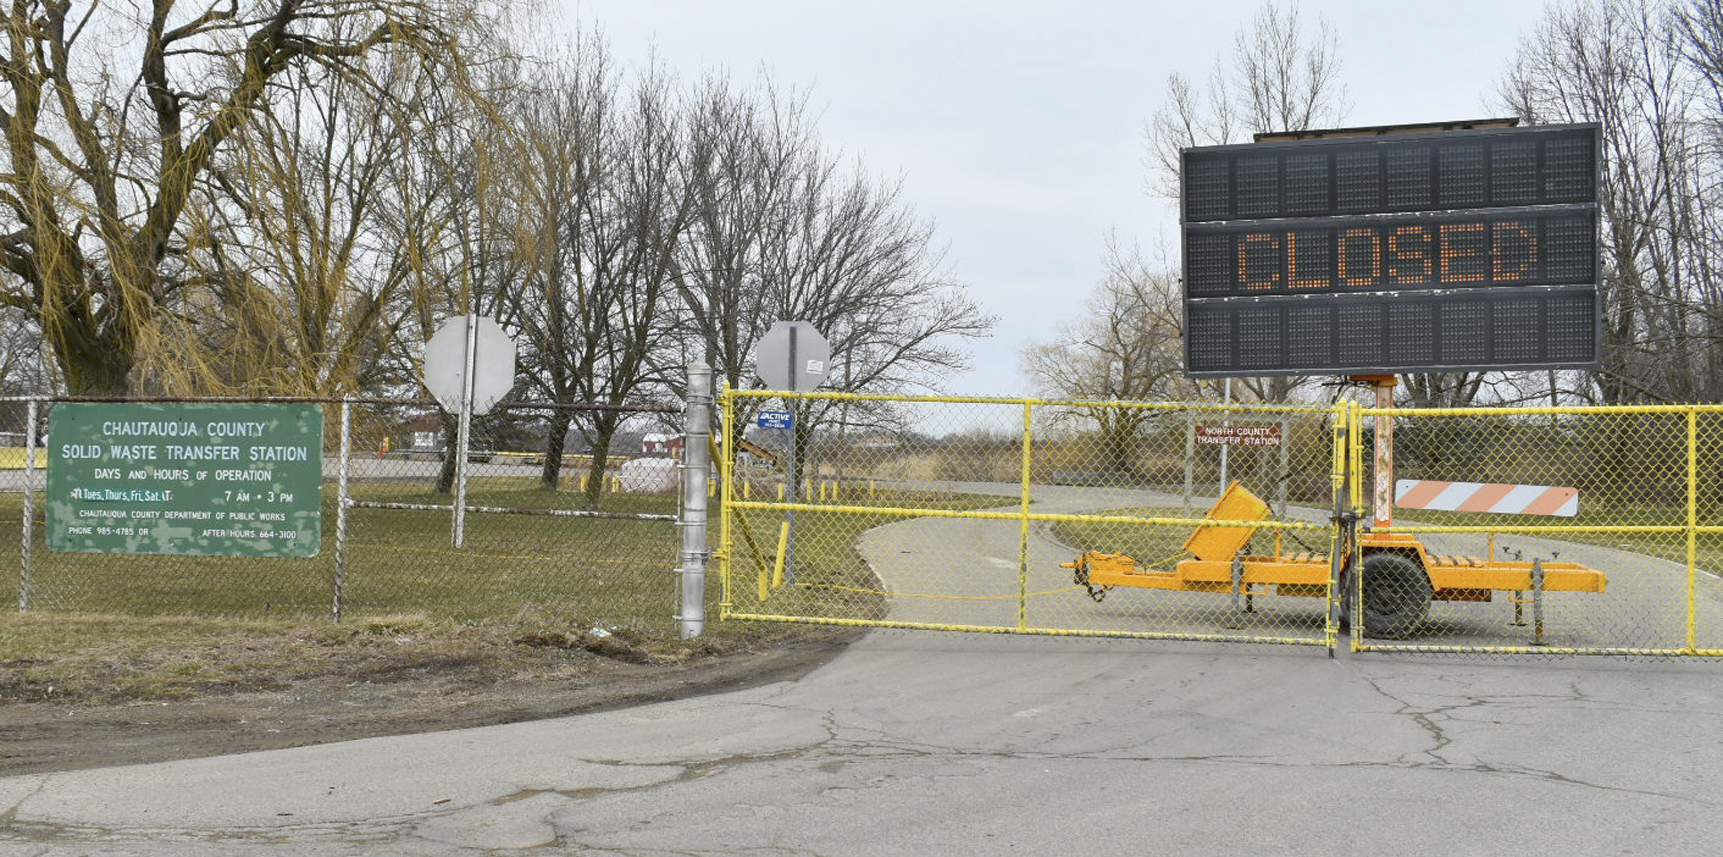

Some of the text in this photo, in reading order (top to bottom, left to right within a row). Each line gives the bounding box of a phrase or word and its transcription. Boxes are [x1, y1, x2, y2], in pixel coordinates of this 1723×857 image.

[1238, 222, 1537, 290] CLOSED
[103, 421, 265, 436] CHAUTAUQUA COUNTY
[1205, 427, 1270, 436] NORTH COUNTY
[1197, 436, 1279, 445] TRANSFER STATION
[62, 444, 307, 461] SOLID WASTE TRANSFER STATION
[94, 468, 272, 481] DAYS AND HOURS OF OPERATION
[225, 490, 232, 502] 7
[236, 493, 250, 502] AM
[268, 491, 275, 503] 3
[280, 493, 293, 503] PM
[79, 509, 286, 521] CHAUTAUQUA COUNTY DEPARTMENT OF PUBLIC WORKS
[68, 526, 93, 535] PHONE
[138, 528, 149, 536] OR
[202, 529, 226, 538] AFTER
[230, 530, 255, 538] HOURS
